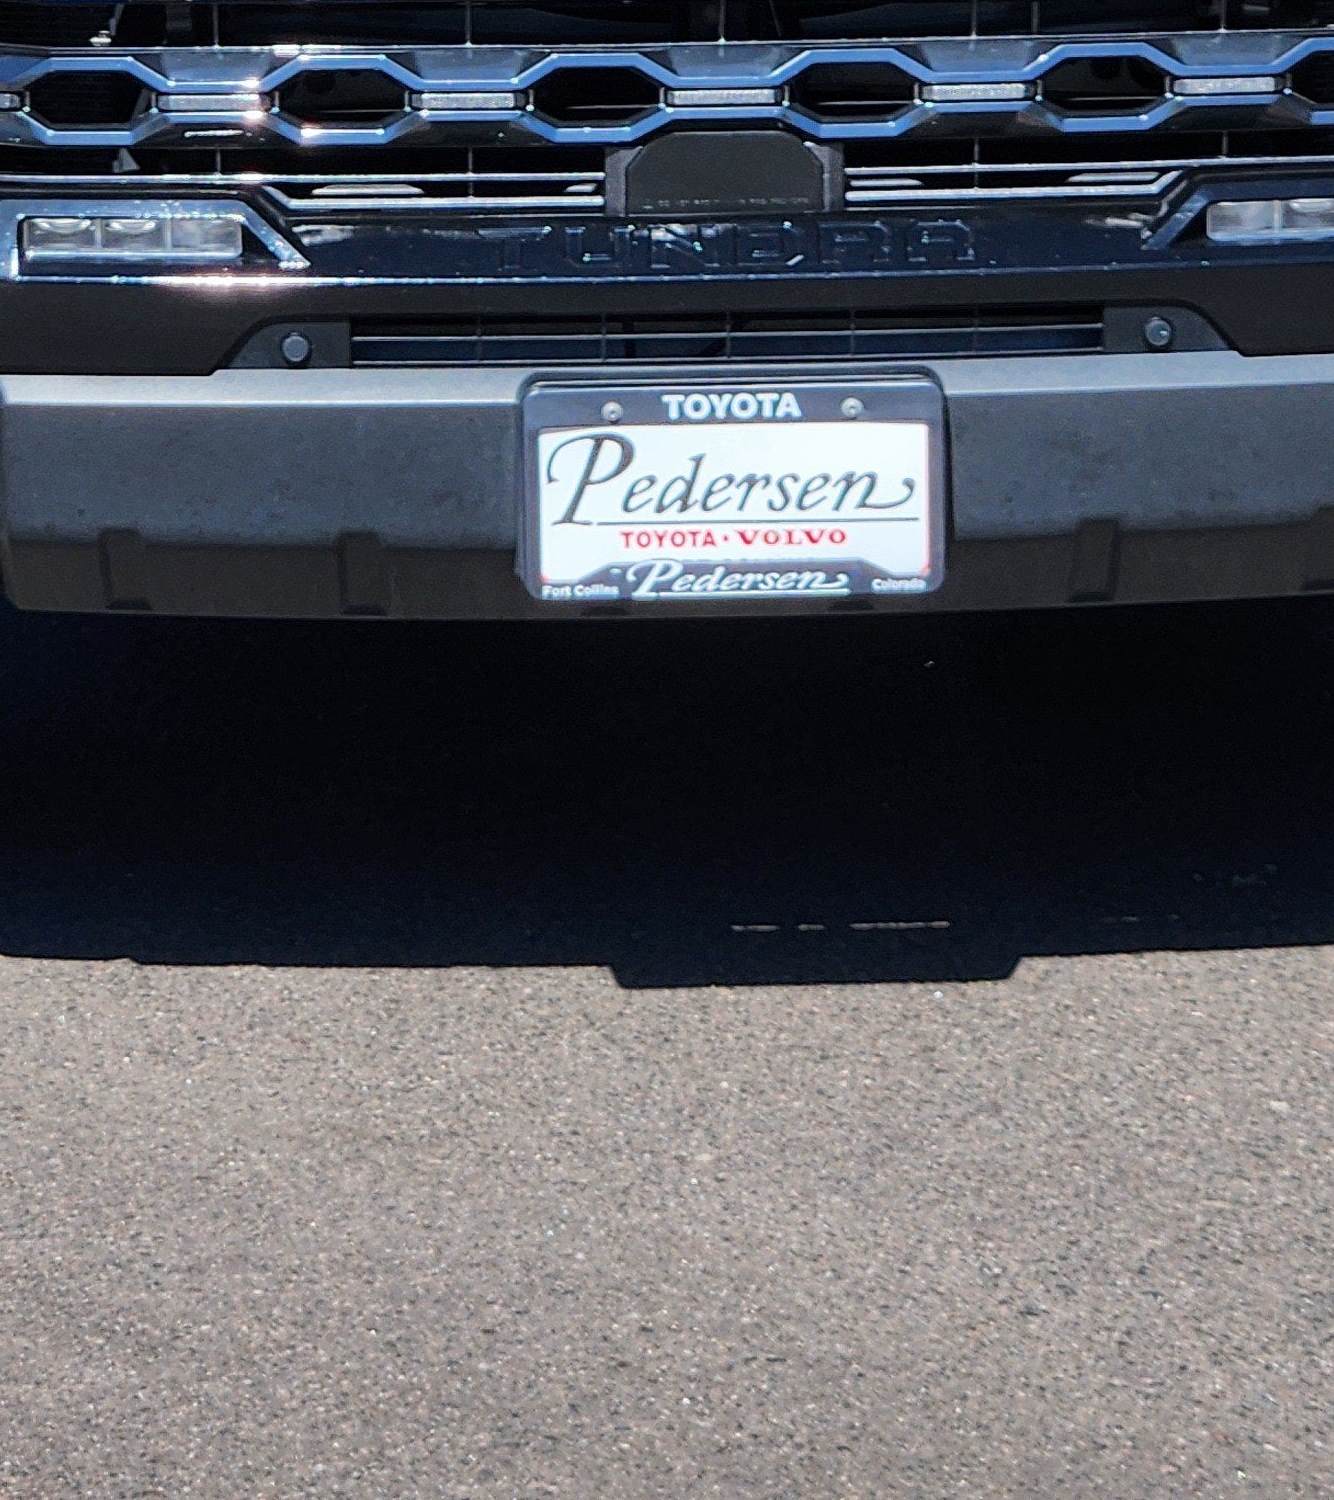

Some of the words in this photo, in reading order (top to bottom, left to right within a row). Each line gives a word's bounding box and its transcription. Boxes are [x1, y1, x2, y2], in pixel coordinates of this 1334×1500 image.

[661, 392, 802, 420] TOYOTA
[547, 431, 916, 525] Pedersen
[620, 531, 718, 548] TOYOTA
[737, 528, 848, 546] VOLVO
[625, 558, 851, 599] Pedersen
